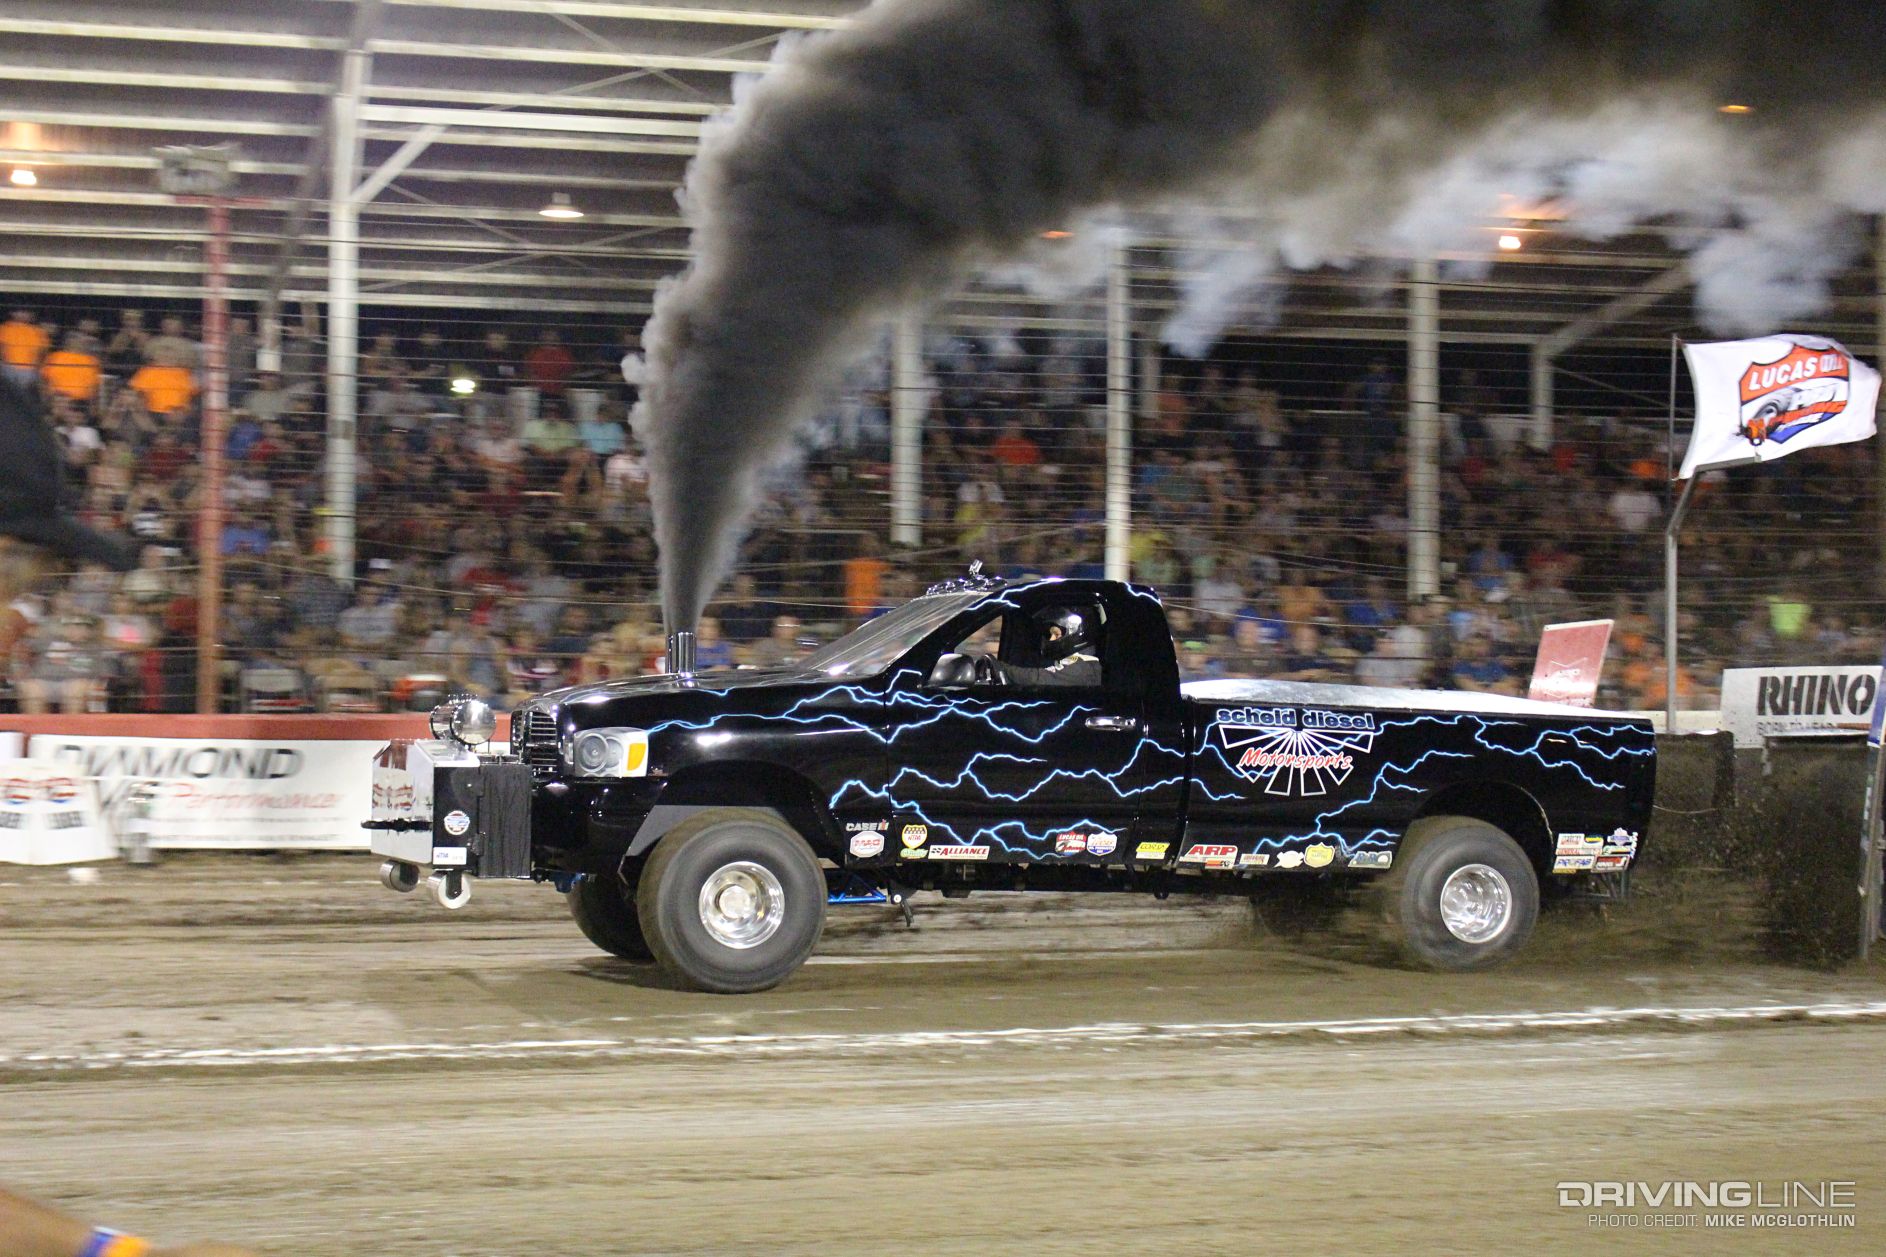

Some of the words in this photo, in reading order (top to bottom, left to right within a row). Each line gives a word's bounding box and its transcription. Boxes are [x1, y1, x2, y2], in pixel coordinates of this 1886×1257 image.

[1748, 356, 1818, 391] LUCAS
[1757, 674, 1876, 716] RHINO
[1302, 710, 1375, 729] diesel
[1240, 747, 1353, 773] Motorsports
[846, 822, 877, 831] CASE
[940, 847, 988, 856] ALLIANCE
[1188, 846, 1237, 856] ARP
